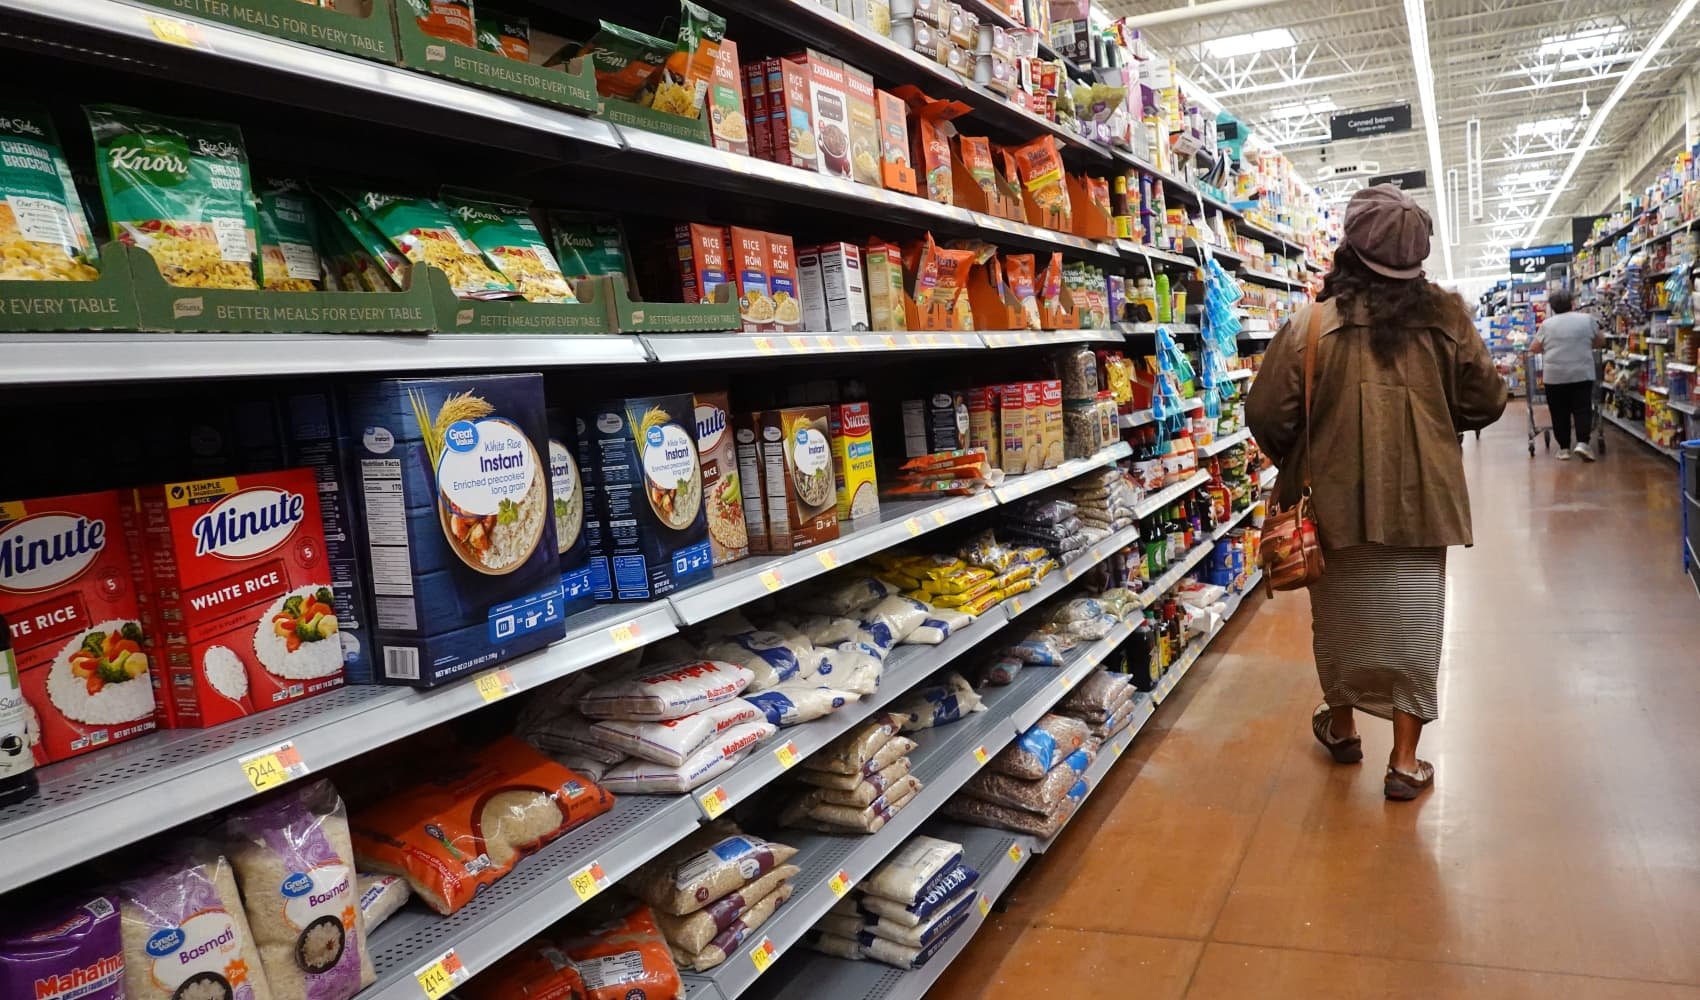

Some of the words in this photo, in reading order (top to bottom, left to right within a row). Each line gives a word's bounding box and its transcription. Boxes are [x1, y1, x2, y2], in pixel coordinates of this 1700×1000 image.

[174, 0, 229, 17] BETTER
[233, 6, 280, 29] MEALS
[283, 17, 309, 36] FOR
[311, 24, 348, 45] EVERY
[350, 33, 385, 53] TABLE
[454, 56, 490, 77] BETTER
[491, 67, 523, 84] MEALS
[524, 75, 541, 88] FOR
[542, 79, 567, 95] EVERY
[568, 86, 592, 100] TABLE
[789, 73, 803, 87] RICE
[1348, 118, 1374, 128] Canned
[1374, 116, 1394, 125] beans
[109, 146, 189, 174] Knorr
[560, 232, 594, 248] Knorr
[702, 237, 719, 249] RICE
[743, 240, 760, 251] RICE
[771, 244, 787, 255] RICE
[705, 254, 721, 265] RONI
[745, 255, 761, 266] RONI
[773, 259, 788, 270] RONI
[11, 299, 66, 315] EVERY
[68, 298, 119, 314] TABLE
[216, 306, 270, 321] BETTER
[273, 307, 319, 321] MEALS
[322, 307, 348, 321] FOR
[350, 307, 385, 321] EVERY
[388, 307, 423, 321] TABLE
[480, 316, 511, 327] BETTER
[511, 316, 540, 328] MEALS
[540, 317, 557, 327] FOR
[557, 317, 579, 328] EVERY
[579, 317, 600, 327] TABLE
[697, 408, 725, 440] nute
[449, 428, 473, 440] Great
[484, 440, 505, 452] White
[507, 439, 521, 449] Rice
[665, 446, 689, 461] Instant
[480, 450, 523, 473] Instant
[551, 464, 569, 477] stant
[703, 466, 717, 479] RICE
[453, 477, 486, 491] Enriched
[487, 472, 525, 488] precooked
[491, 485, 508, 496] long
[508, 482, 525, 494] grain
[186, 485, 192, 498] 1
[193, 481, 221, 492] SIMPLE
[194, 492, 304, 554] Minute
[304, 548, 312, 559] 5
[703, 549, 708, 560] 5
[107, 579, 117, 590] 5
[584, 575, 589, 588] 5
[190, 584, 243, 612] WHITE
[244, 571, 280, 594] RICE
[546, 600, 556, 616] 5
[36, 606, 77, 630] RICE
[248, 761, 276, 787] 244
[284, 877, 308, 890] Great
[576, 875, 591, 894] 857
[308, 879, 350, 908] Basmati
[150, 931, 178, 949] Great
[179, 927, 234, 965] Basmati
[425, 970, 444, 993] 414
